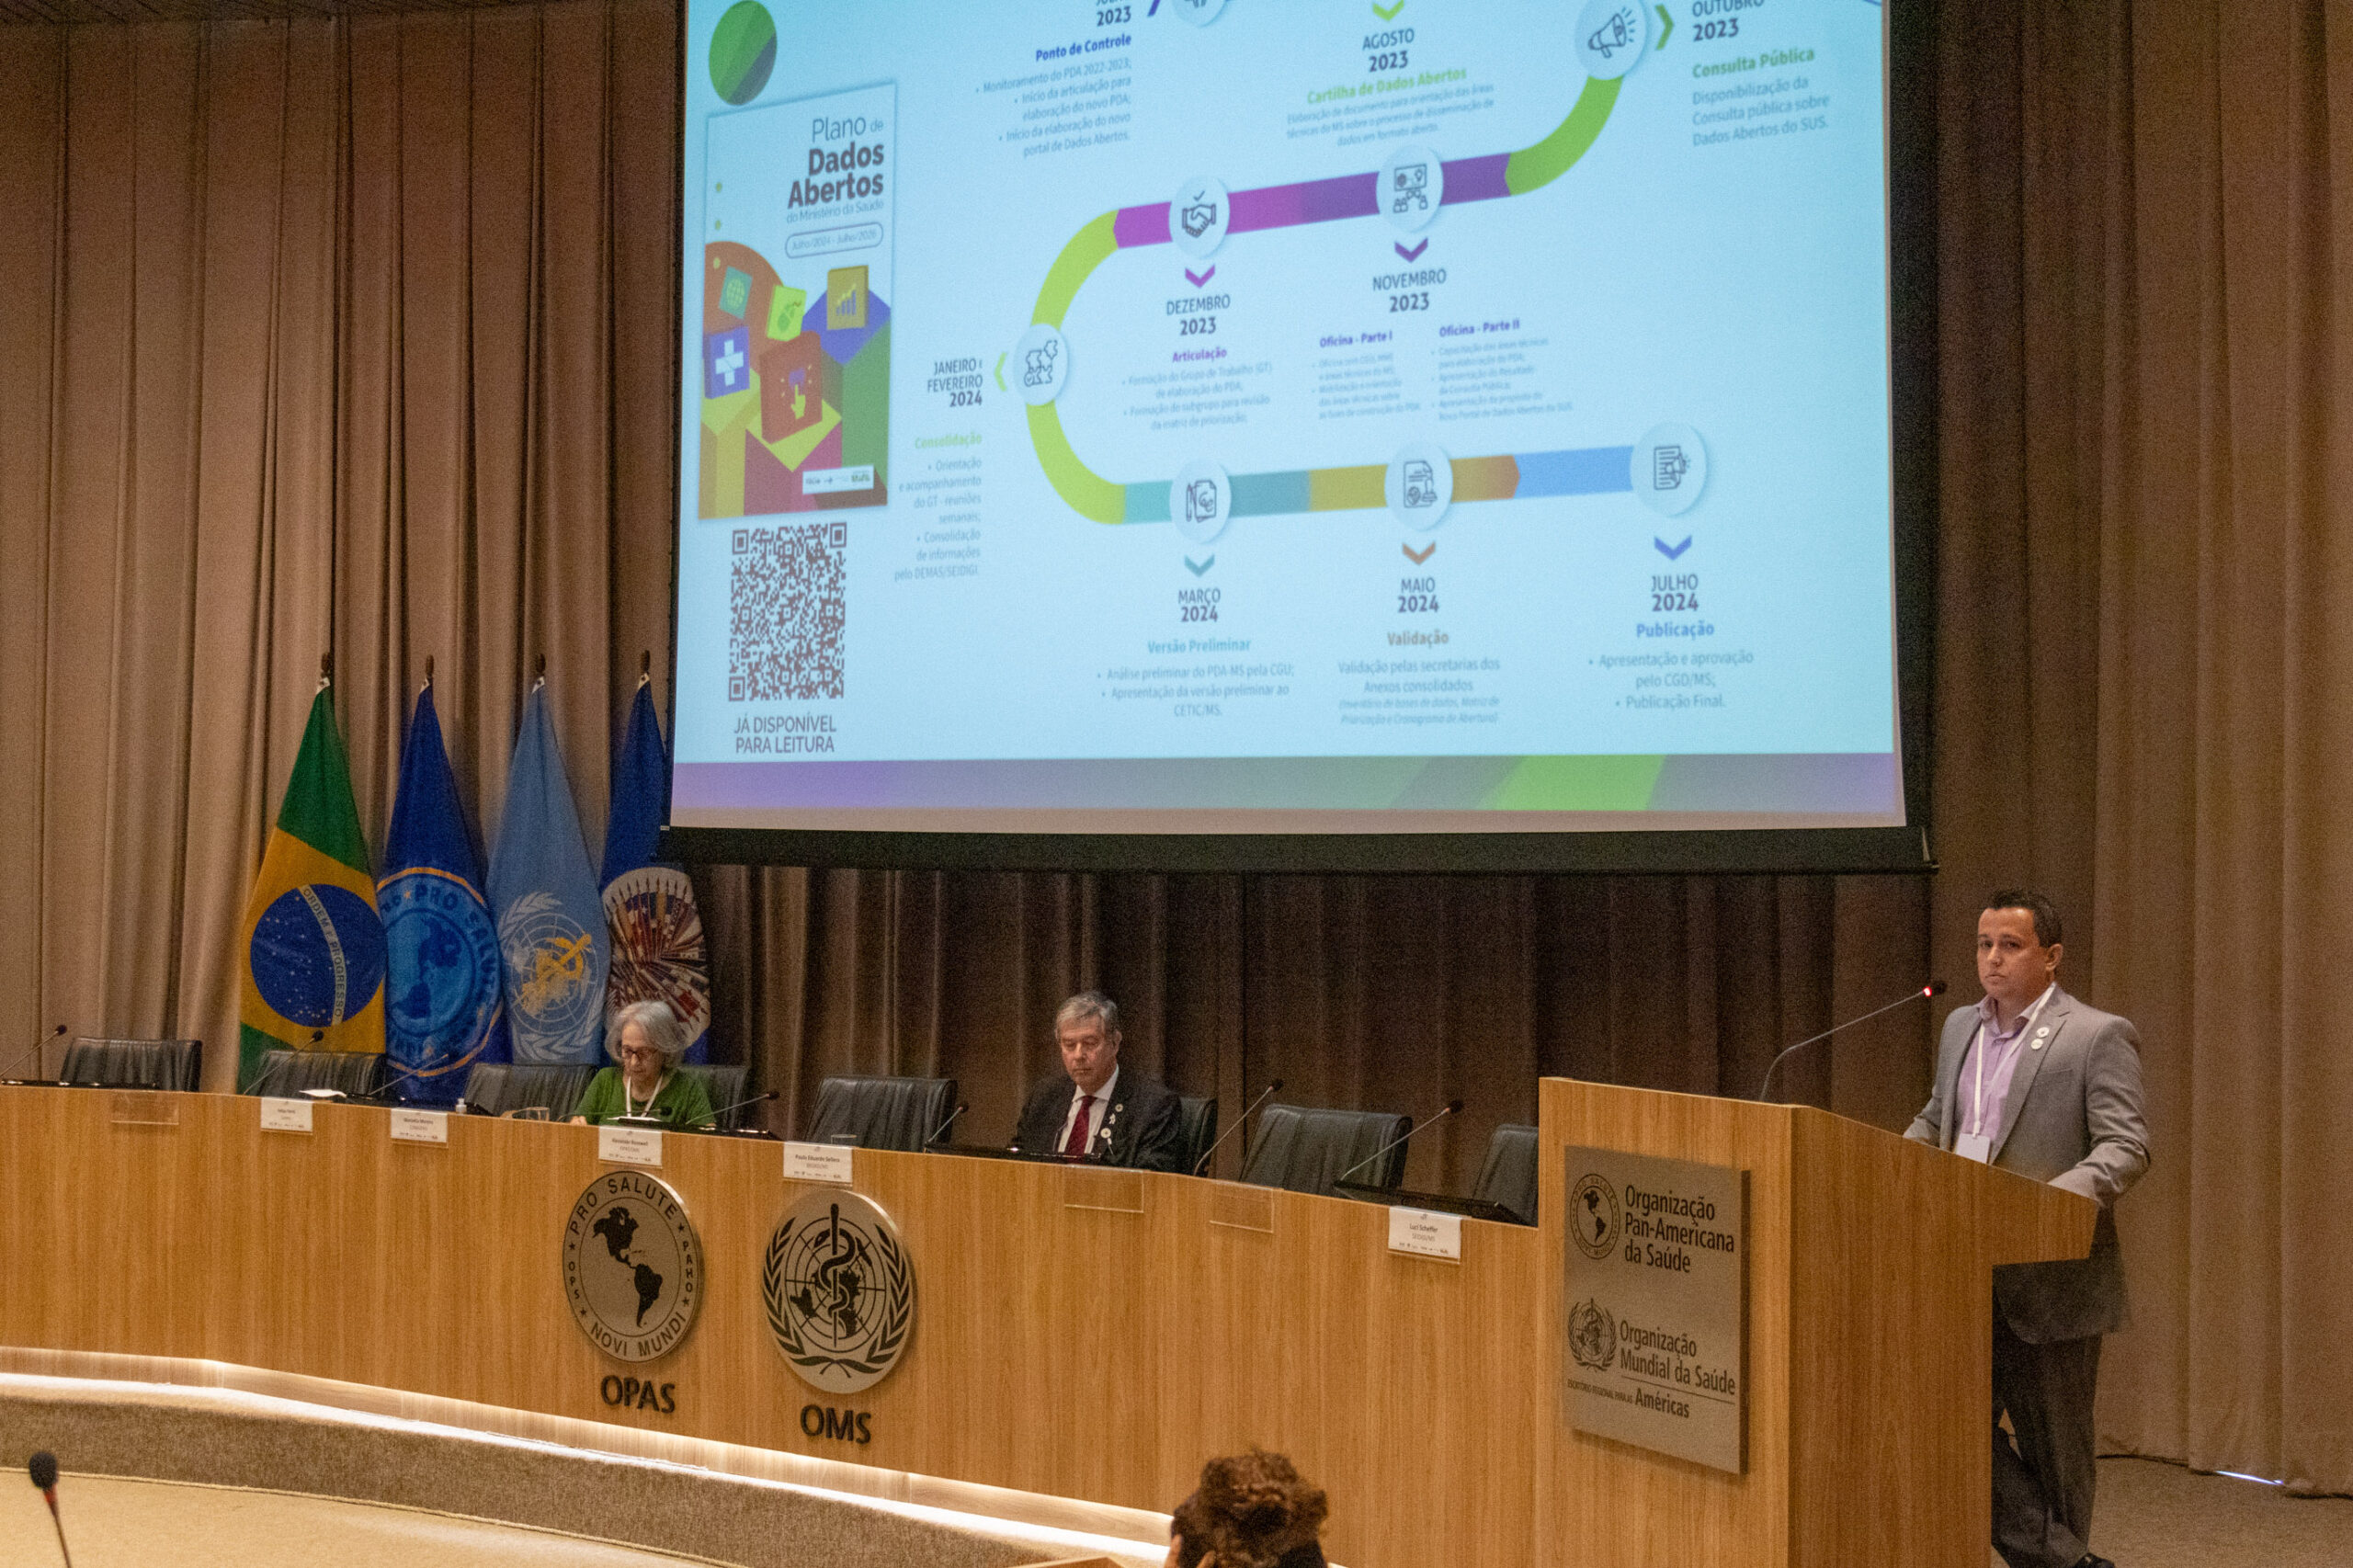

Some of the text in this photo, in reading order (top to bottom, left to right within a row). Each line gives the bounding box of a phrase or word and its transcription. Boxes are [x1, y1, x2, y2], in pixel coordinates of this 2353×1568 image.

[1097, 6, 1131, 27] 2023
[1362, 28, 1415, 51] AGOSTO
[1692, 17, 1740, 42] 2023
[1036, 34, 1131, 62] Ponto de Controle
[1369, 51, 1409, 72] 2023
[1692, 47, 1816, 78] Consulta Pública
[983, 73, 1049, 93] Monitoramento
[1051, 70, 1062, 81] do
[1063, 65, 1082, 79] PDA
[1110, 76, 1131, 90] para
[1307, 67, 1467, 104] Cartilha de Dados Abertos
[1692, 75, 1810, 106] Disponibilização da
[1022, 102, 1071, 121] elaboração
[1073, 99, 1084, 112] do
[1086, 98, 1108, 110] novo
[1692, 94, 1831, 126] Consulta pública sobre
[812, 116, 884, 143] Plano de
[1045, 117, 1093, 135] elaboração
[1095, 114, 1106, 127] do
[1108, 112, 1131, 124] novo
[1693, 130, 1730, 147] Dados
[1733, 123, 1779, 140] Abertos
[1781, 119, 1798, 134] do
[1064, 134, 1092, 150] Dados
[808, 140, 885, 176] Dados
[787, 171, 884, 210] Abertos
[786, 211, 799, 224] do
[1372, 267, 1448, 292] NOVEMBRO
[1165, 293, 1232, 316] DEZEMBRO
[1389, 290, 1431, 313] 2023
[1179, 315, 1218, 337] 2023
[1438, 324, 1475, 338] Oficina
[1483, 320, 1511, 334] Parte
[1319, 329, 1393, 348] Oficina Parte I
[1172, 346, 1228, 363] Articulação
[933, 357, 977, 377] JANEIRO
[926, 373, 983, 393] FEVEREIRO
[949, 389, 983, 408] 2024
[915, 431, 983, 449] Consolidação
[936, 457, 983, 472] Orientação
[905, 476, 982, 493] acompanhamento
[914, 492, 982, 508] do GT reuniões
[924, 528, 981, 544] Consolidação
[915, 546, 981, 562] de informações
[894, 568, 913, 583] pelo
[1400, 576, 1436, 593] MAIO
[1651, 573, 1699, 593] JULHO
[1177, 586, 1222, 606] MARÇO
[1397, 594, 1440, 614] 2024
[1651, 592, 1699, 612] 2024
[1180, 605, 1219, 623] 2024
[1387, 628, 1449, 649] Validação
[1636, 619, 1715, 641] Publicação
[1147, 637, 1252, 653] Versão Preliminar
[1338, 656, 1501, 676] Validação pelas secretarias dos
[1598, 649, 1755, 671] Apresentação e aprovação
[1107, 665, 1140, 680] Análise
[1142, 666, 1190, 681] preliminar
[1192, 665, 1205, 678] do
[1246, 663, 1267, 678] pela
[1635, 675, 1662, 690] pelo
[1111, 683, 1290, 701] Apresentação da versão preliminar ao
[1364, 677, 1474, 693] Anexos consolidados
[1626, 693, 1690, 711] Publicação
[733, 710, 837, 734] JÁ DISPONÍVEL
[735, 735, 835, 754] PARA LEITURA
[303, 888, 330, 926] ORDEM
[329, 941, 346, 1017] PROGRESSO
[570, 1176, 677, 1235] PRO SALUTE
[1625, 1185, 1716, 1227] Organização
[1625, 1211, 1734, 1253] Pan-Americana
[683, 1241, 694, 1293] PAHO
[1624, 1239, 1642, 1264] da
[1646, 1243, 1691, 1274] Saúde
[568, 1261, 581, 1300] OPS
[590, 1312, 688, 1358] NOVI MUNDI
[1620, 1319, 1698, 1360] Organização
[1620, 1346, 1736, 1396] Mundial da Saúde
[601, 1375, 676, 1415] OPAS
[1635, 1387, 1690, 1420] Américas
[800, 1403, 871, 1445] OMS
